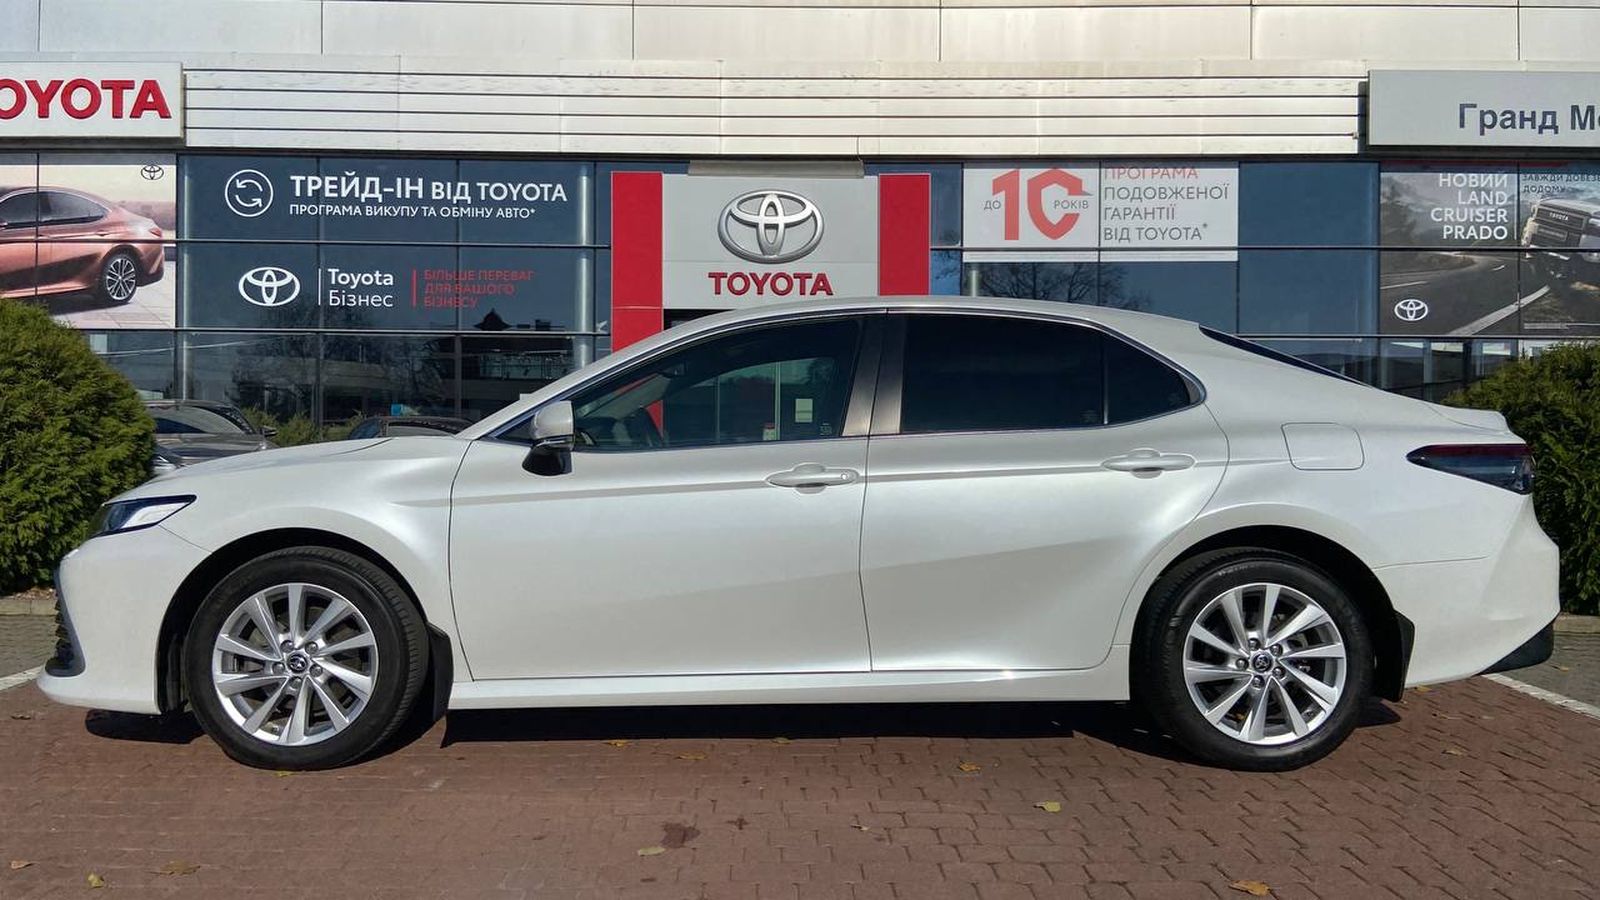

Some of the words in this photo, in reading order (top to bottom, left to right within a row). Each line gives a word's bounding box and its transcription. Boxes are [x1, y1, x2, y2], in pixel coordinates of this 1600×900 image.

[1459, 103, 1559, 136] Гранд
[1570, 104, 1600, 131] М
[1104, 166, 1199, 180] ПРОГРАМА
[290, 171, 423, 203] ТРЕЙД-ІН
[431, 182, 472, 204] ВІД
[476, 182, 568, 202] TOYOTA
[1104, 183, 1230, 203] ПОДОВЖЕНОЇ
[984, 200, 1002, 211] ДО
[1053, 200, 1089, 210] РОКІВ
[1458, 190, 1508, 206] LAND
[289, 204, 362, 216] ПРОГРАМА
[365, 205, 419, 217] ВИКУПУ
[421, 206, 437, 217] ТА
[440, 206, 493, 219] ОБМІНУ
[1104, 203, 1177, 220] ГАРАНТІЇ
[1430, 207, 1508, 223] CRUISER
[1104, 227, 1131, 243] ВІД
[1443, 225, 1508, 240] PRADO
[327, 268, 394, 289] Toyota
[424, 269, 476, 280] БІЛЬШЕ
[479, 270, 535, 281] ПЕРЕВАГ
[708, 271, 834, 296] TOYOTA
[329, 289, 394, 307] Бізнес
